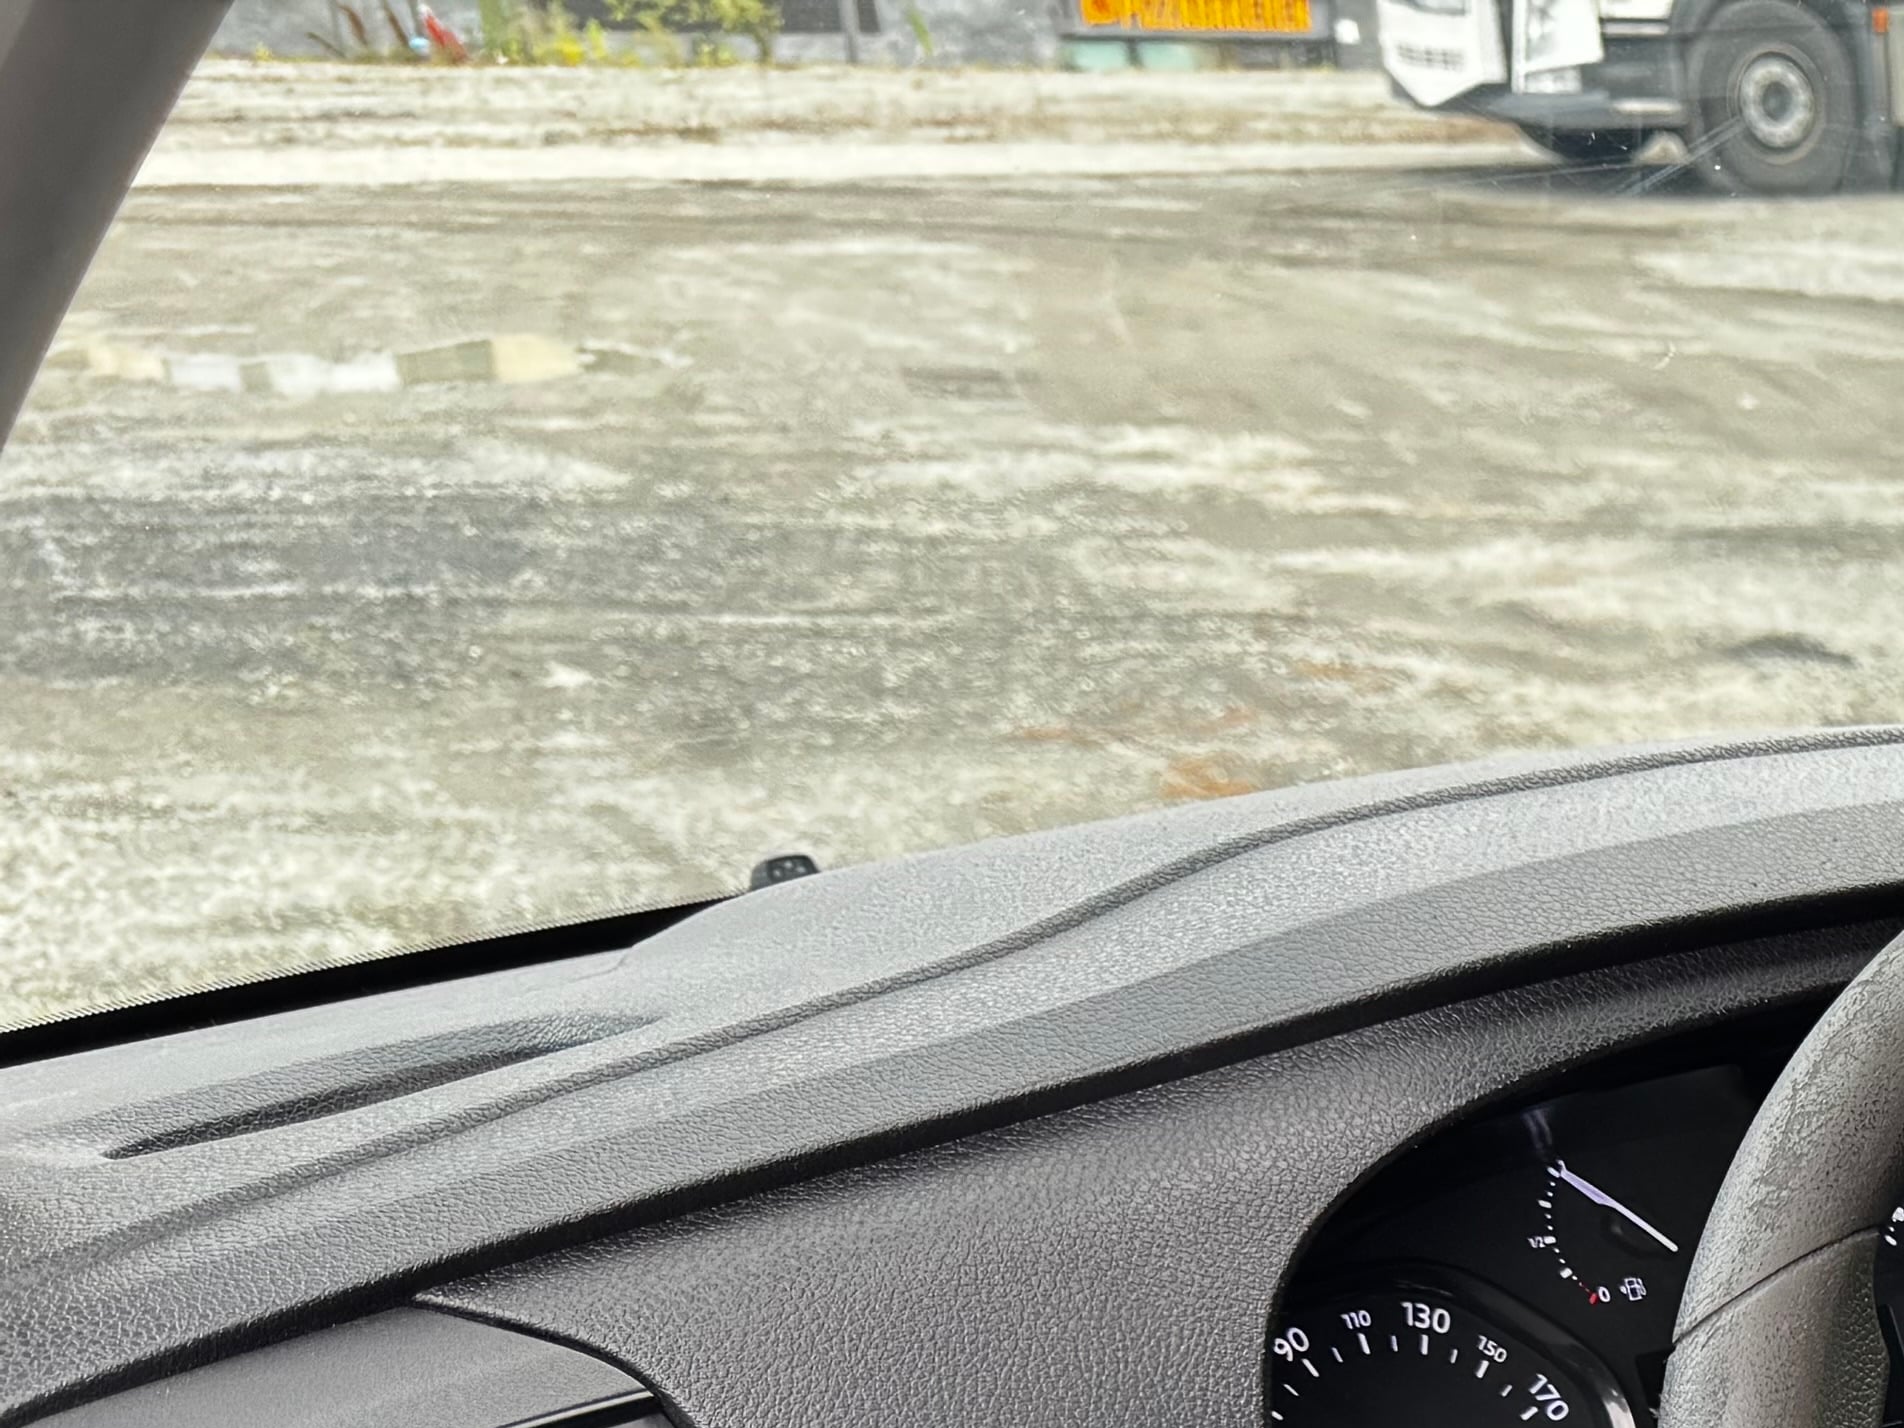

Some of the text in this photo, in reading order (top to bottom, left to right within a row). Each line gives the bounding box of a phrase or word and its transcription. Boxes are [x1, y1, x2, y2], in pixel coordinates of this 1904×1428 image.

[1340, 1309, 1372, 1330] 110
[1401, 1301, 1451, 1334] 130
[1273, 1326, 1310, 1362] 90
[1477, 1334, 1508, 1363] 150
[1528, 1373, 1570, 1421] 170
